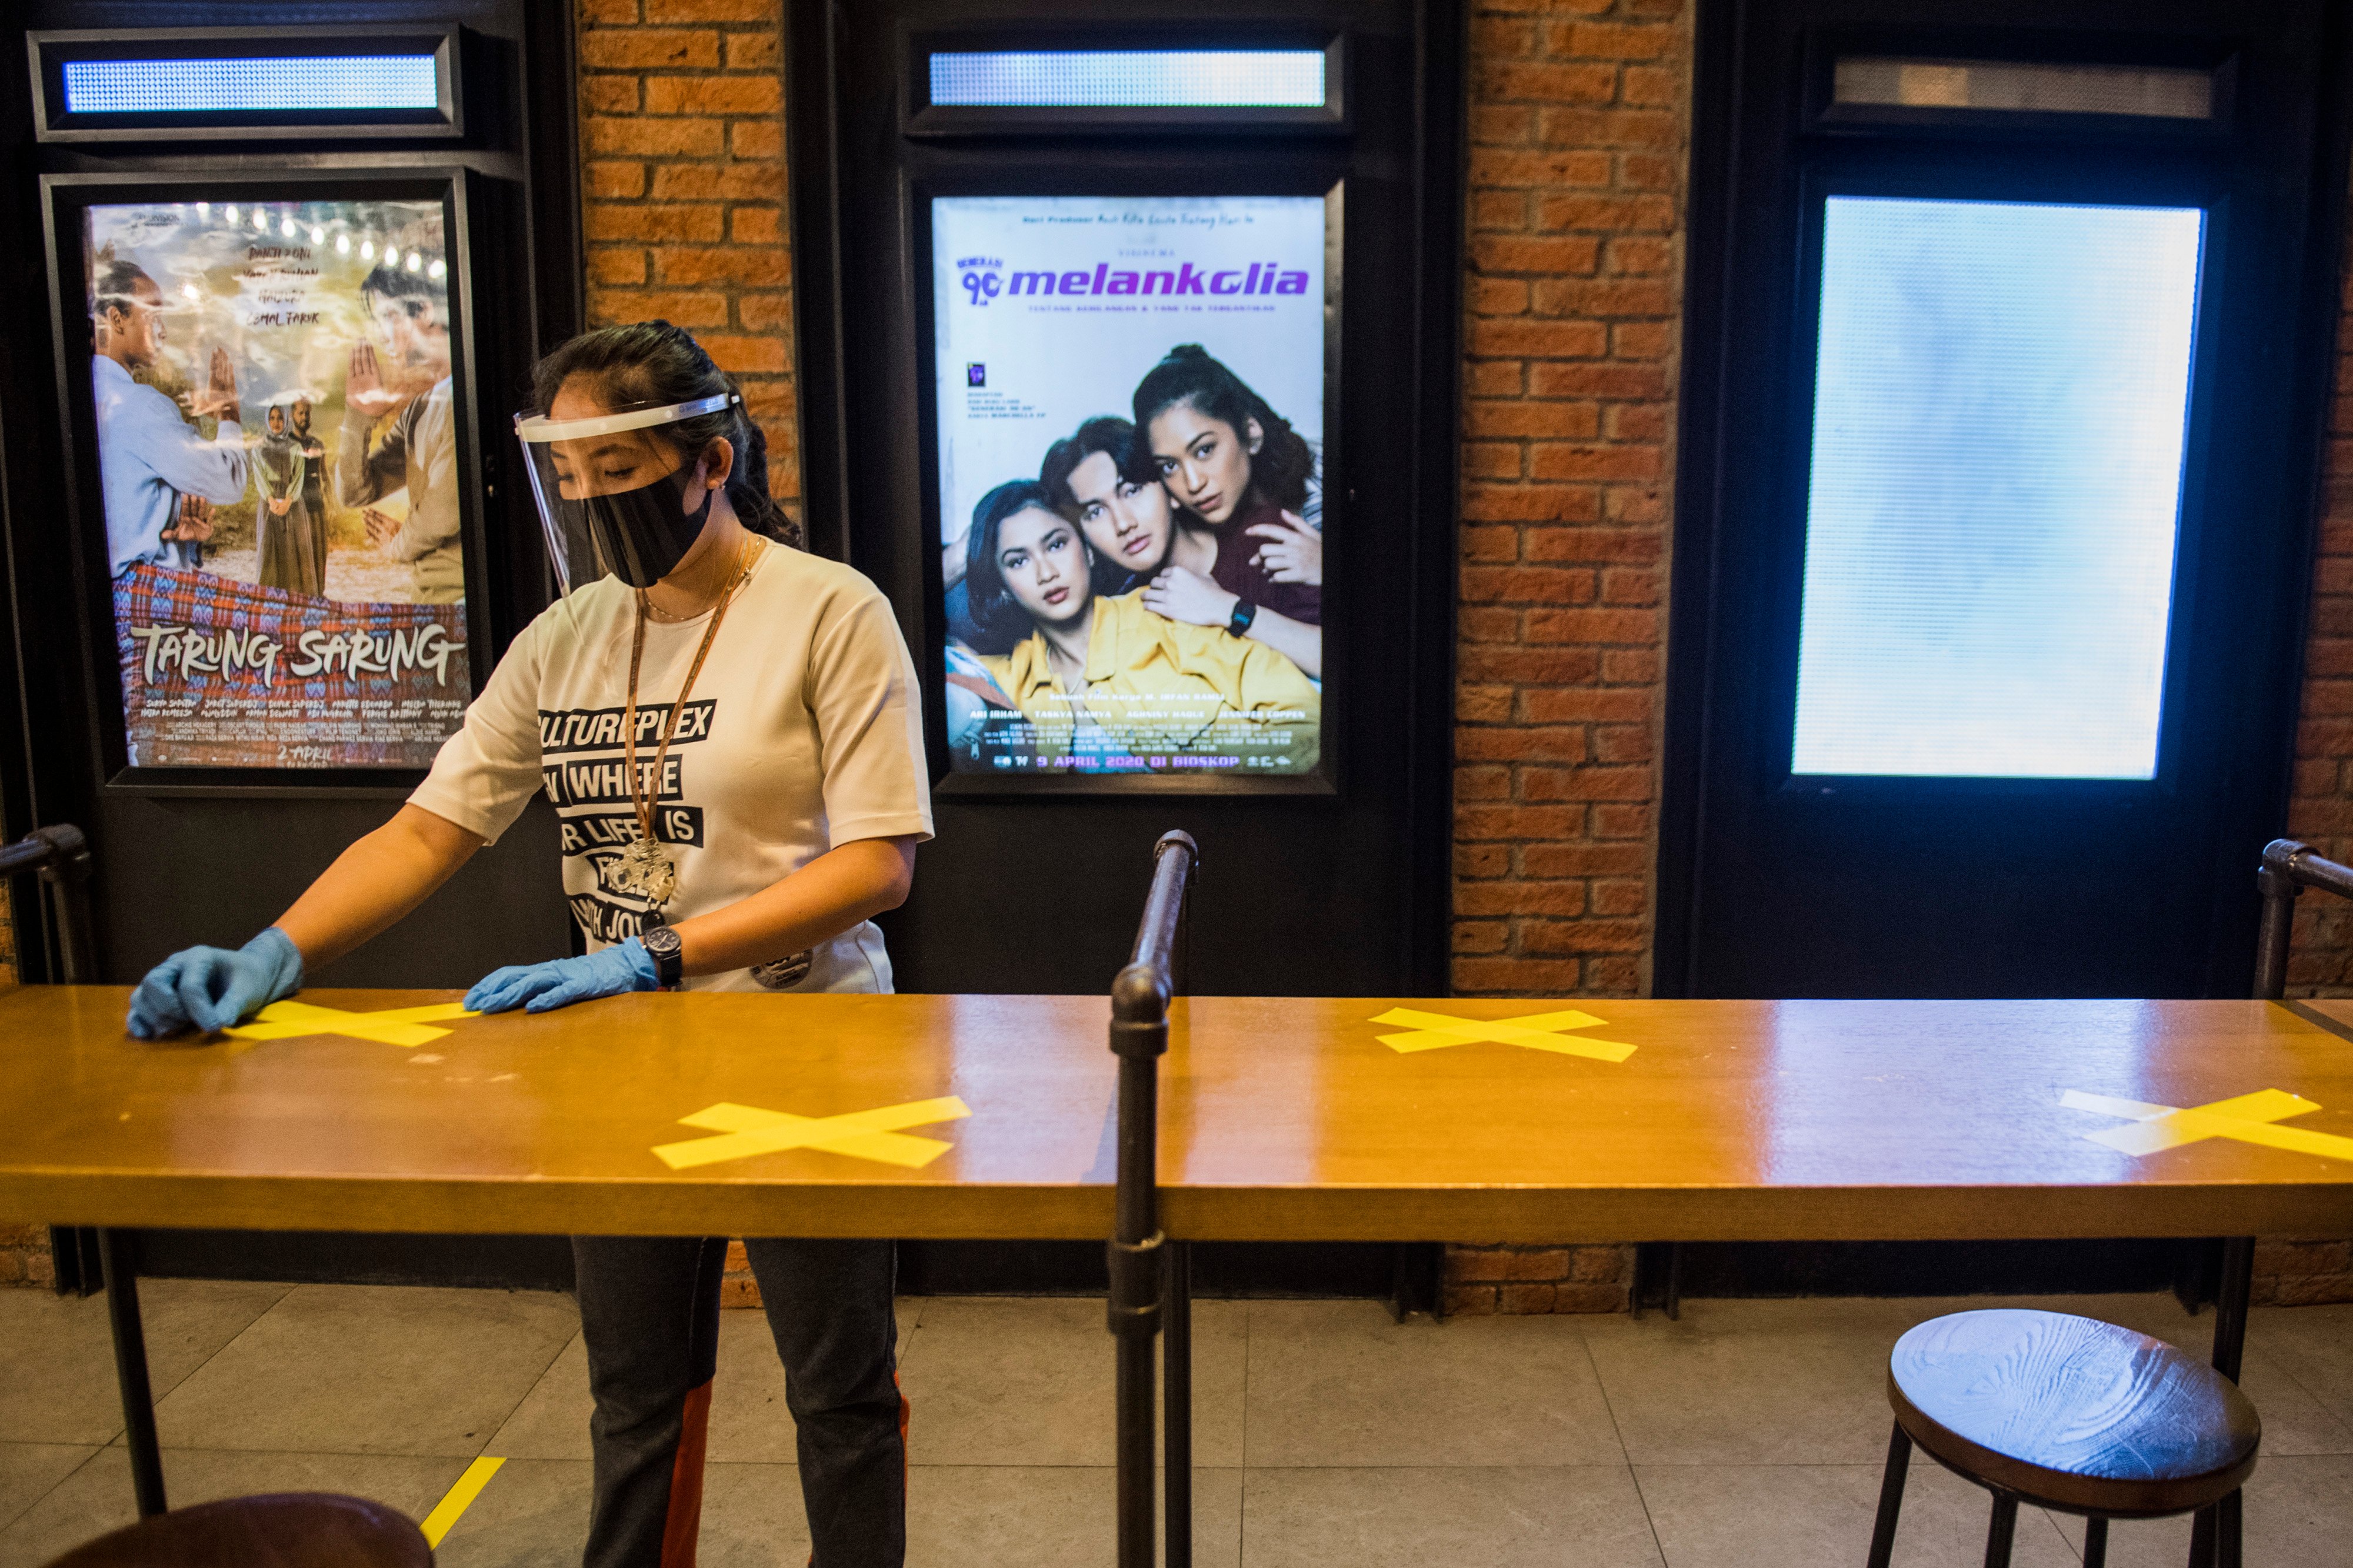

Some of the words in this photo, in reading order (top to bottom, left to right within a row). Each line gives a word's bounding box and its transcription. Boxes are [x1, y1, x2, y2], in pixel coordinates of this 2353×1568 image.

[131, 623, 284, 688] TARUNG
[291, 623, 466, 687] SARUNG
[537, 706, 712, 748] ULTUREPLEX
[970, 710, 987, 719] ARI
[990, 710, 1022, 719] IRHAM
[289, 745, 334, 761] APRIL
[1036, 756, 1048, 767] 9
[1054, 756, 1099, 767] APRIL
[1105, 756, 1145, 767] 2020
[1149, 756, 1166, 768] DI
[1172, 756, 1240, 768] BIOSKOP
[569, 761, 678, 798] WHERE
[584, 818, 643, 843] LIFE
[665, 810, 694, 840] IS
